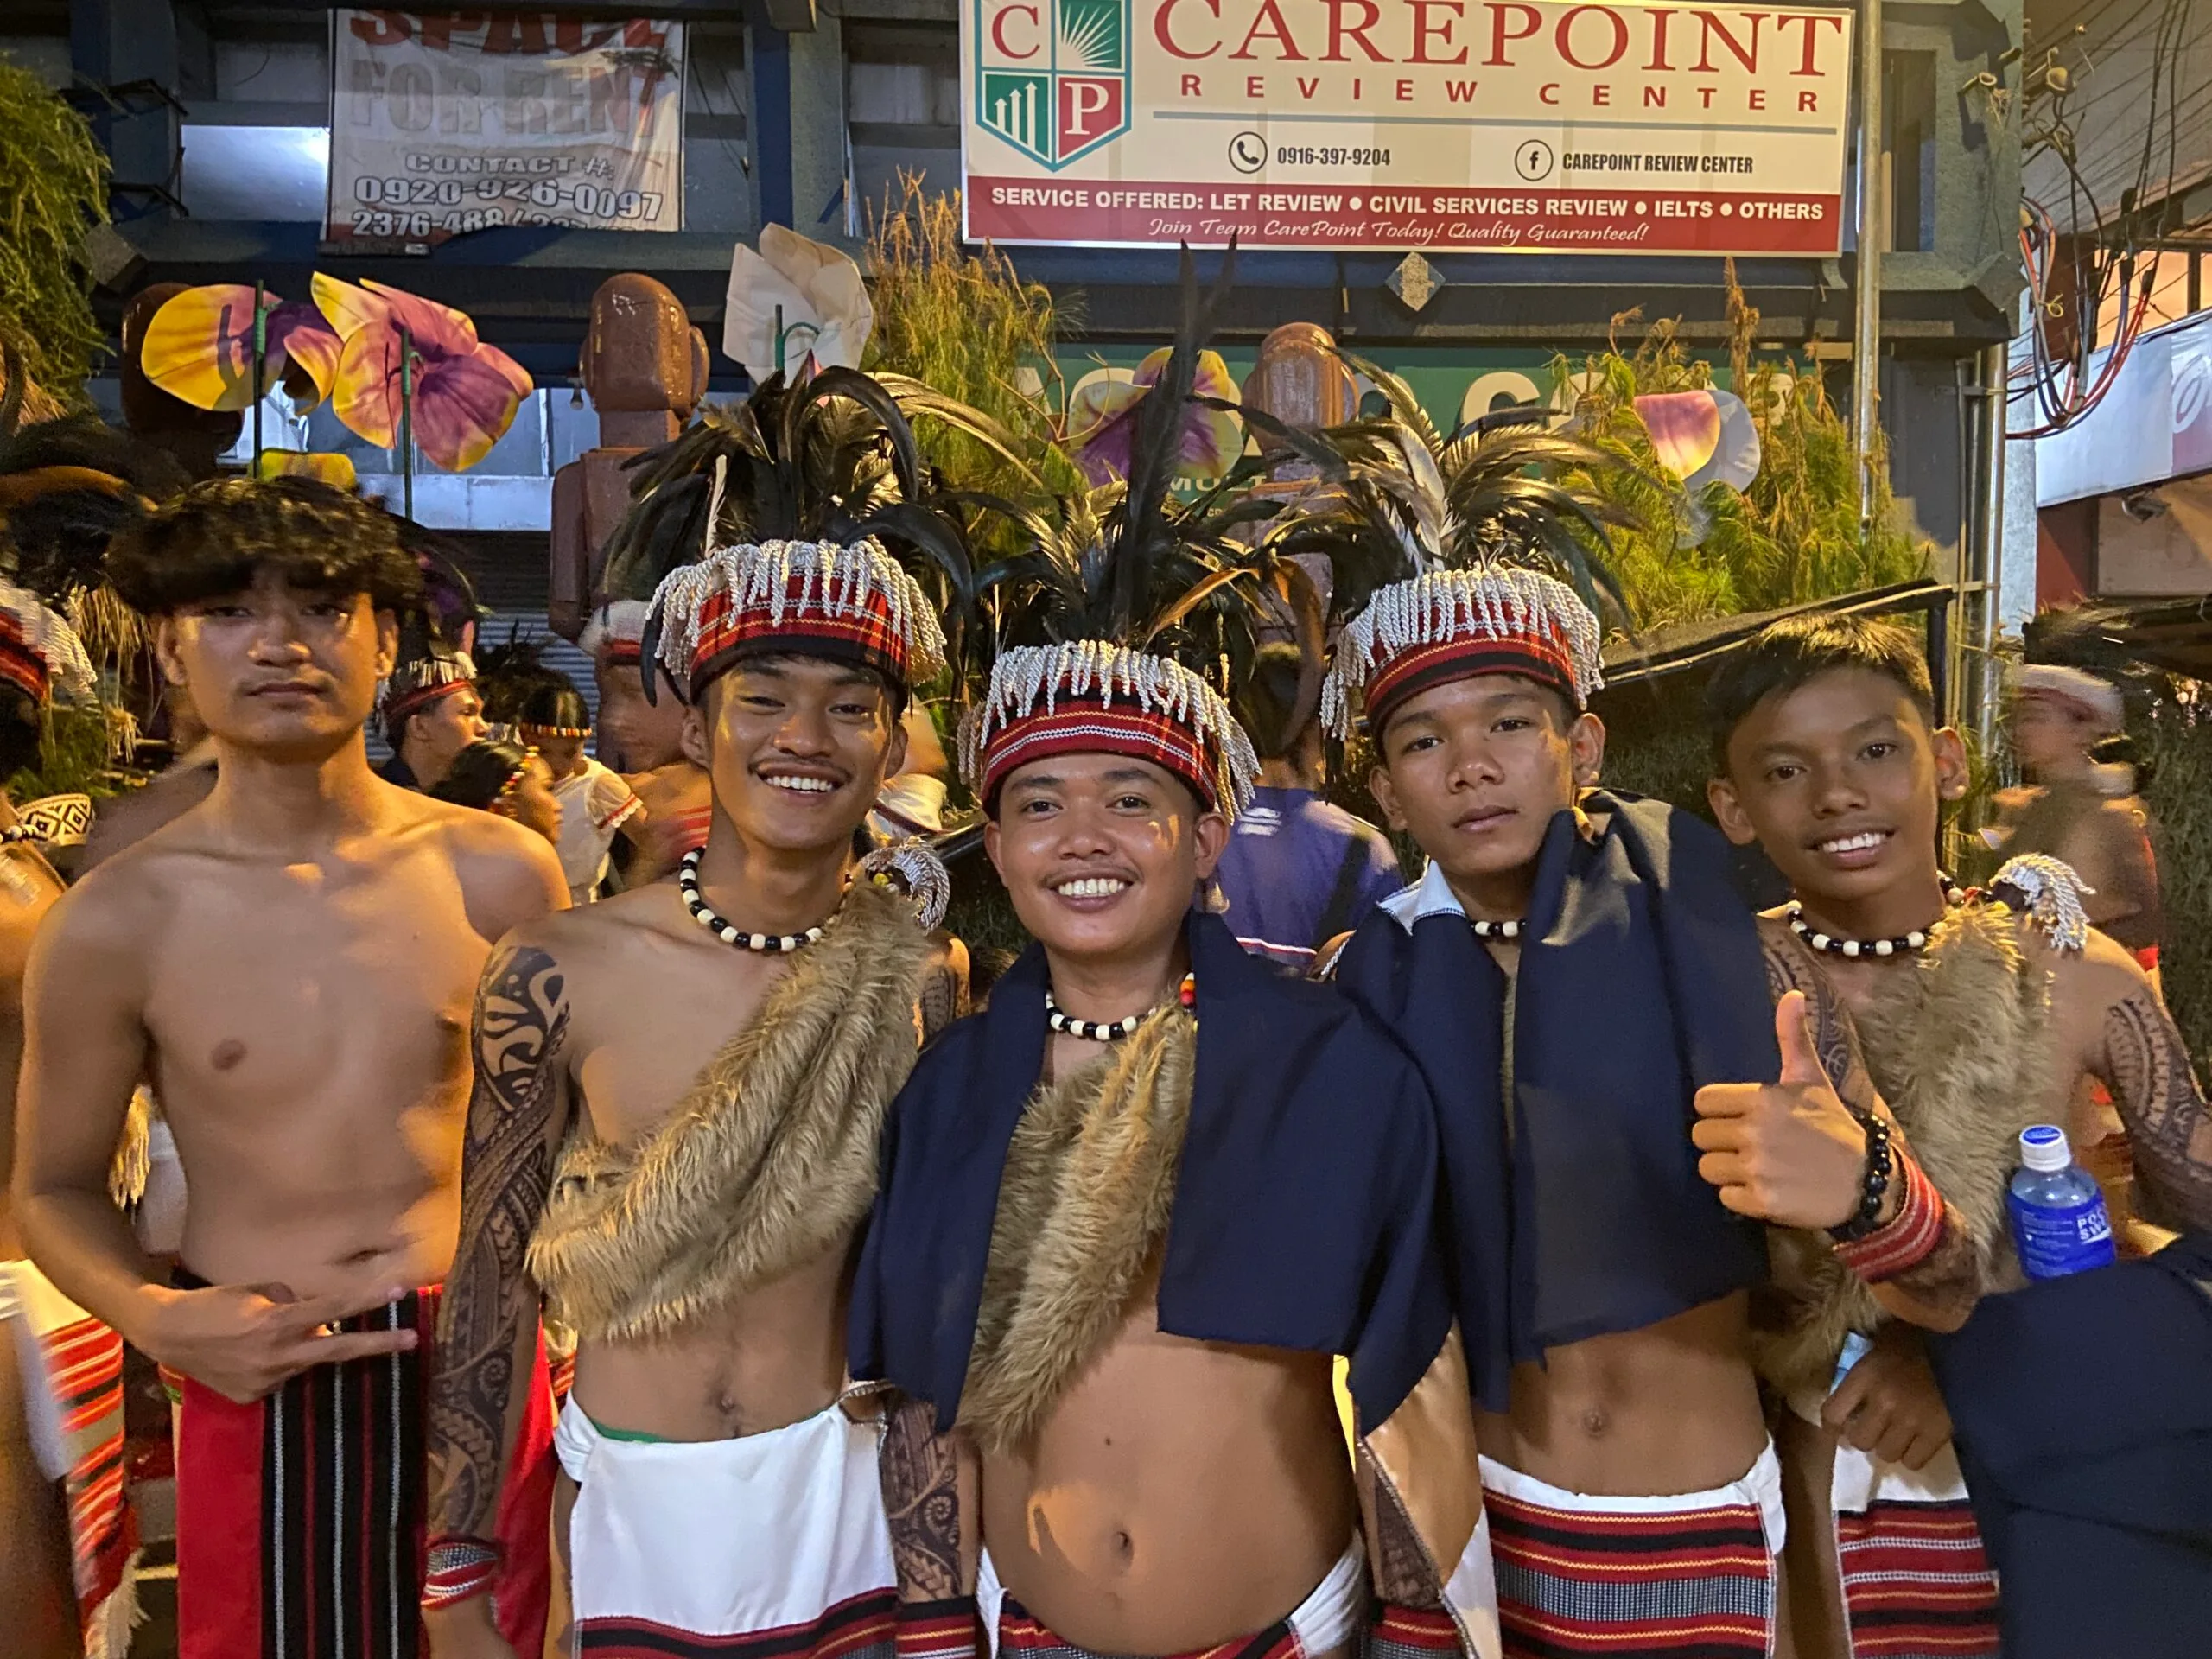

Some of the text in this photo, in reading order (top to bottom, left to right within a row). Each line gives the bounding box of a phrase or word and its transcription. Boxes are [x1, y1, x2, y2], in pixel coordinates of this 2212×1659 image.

[991, 4, 1041, 60] C
[1154, 0, 1842, 76] CAREPOINT
[350, 59, 666, 137] FOR RENT
[1065, 81, 1109, 136] P
[1181, 73, 1818, 112] REVIEW CENTER
[405, 153, 575, 174] CONTACT
[1277, 146, 1391, 166] 0916-397-9204
[1562, 153, 1753, 174] CAREPOINT REVIEW CENTER
[354, 175, 664, 221] 0920-926-0097
[992, 187, 1823, 219] SERVICE OFFERED: LET REVIEW CIVIL SERVICES REVIEW IELTS OTHERS
[1148, 219, 1649, 247] Join Team CarePoint Today! Quality Guaranteed!
